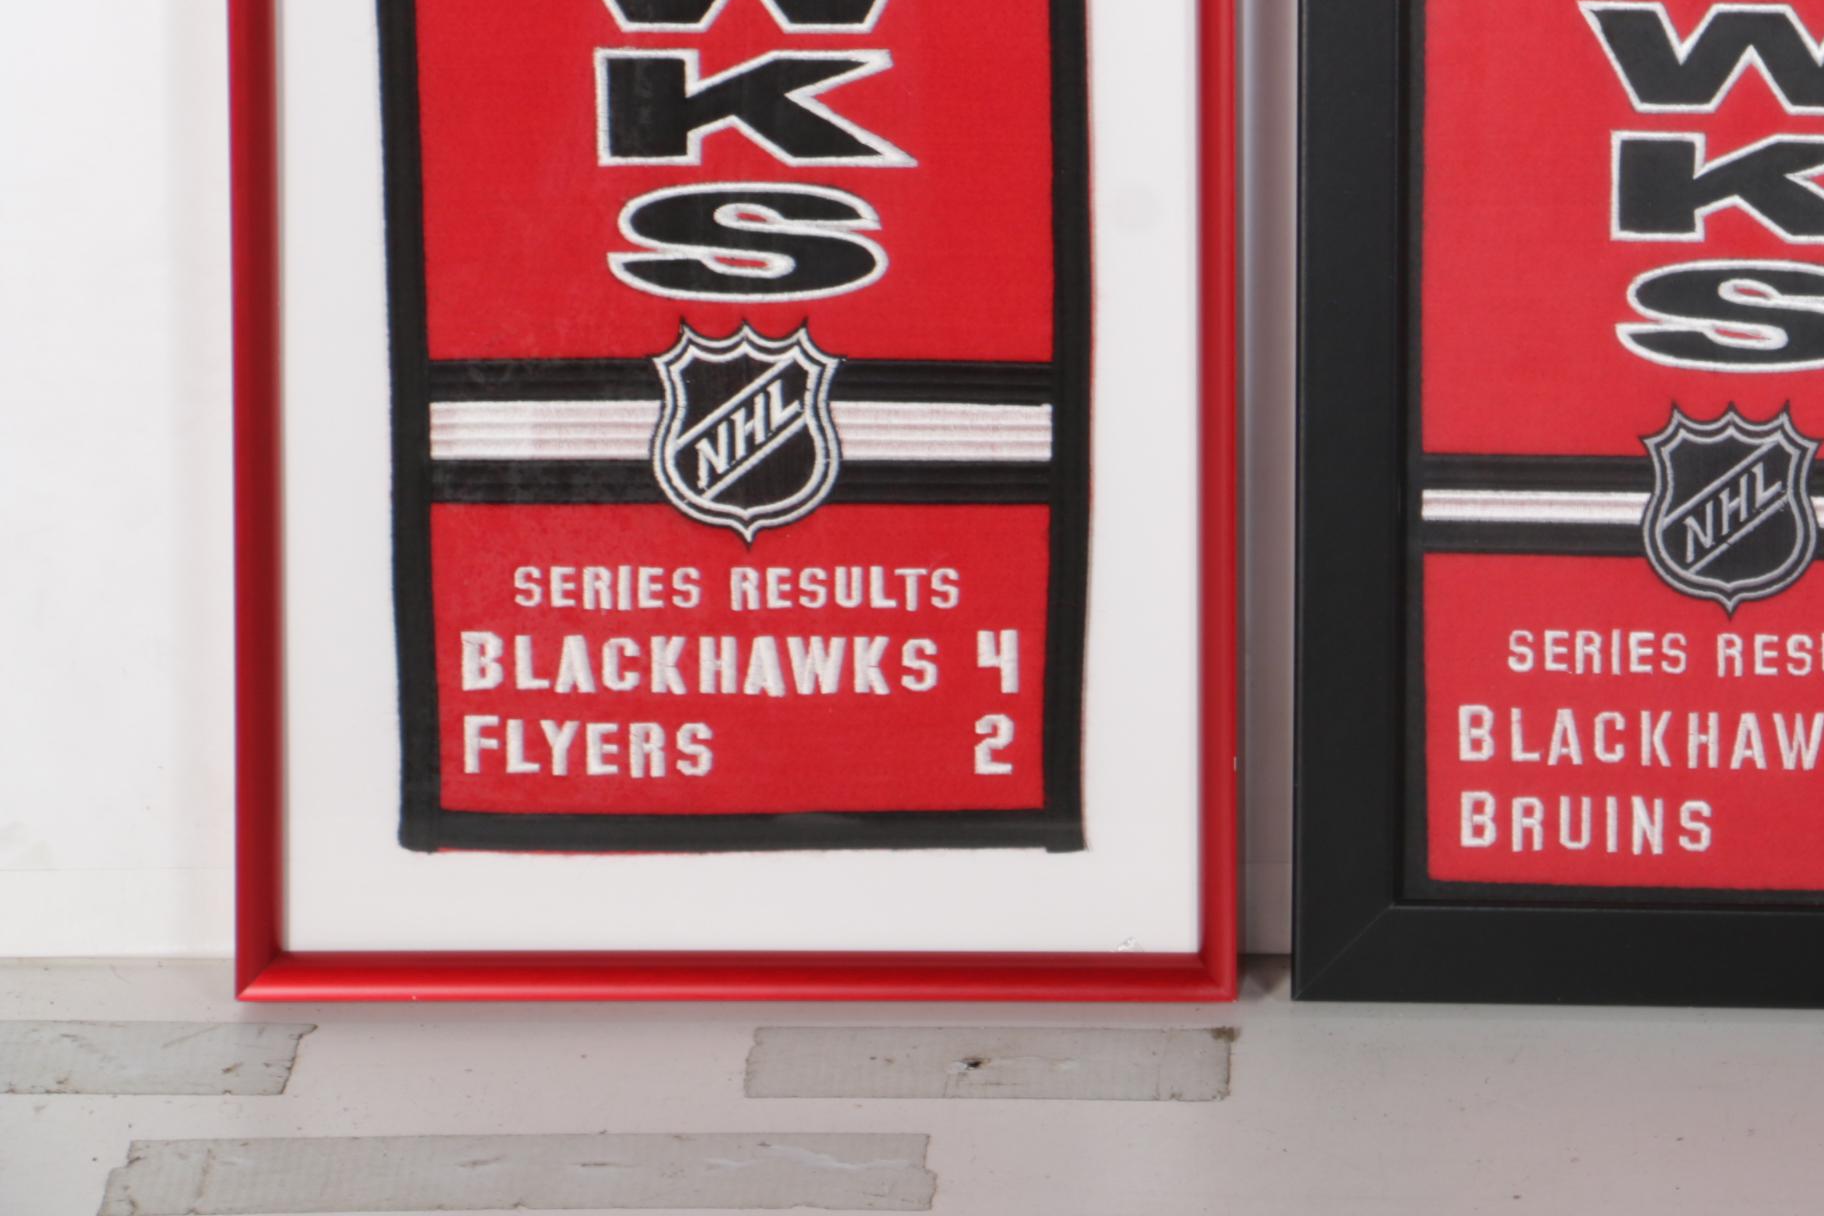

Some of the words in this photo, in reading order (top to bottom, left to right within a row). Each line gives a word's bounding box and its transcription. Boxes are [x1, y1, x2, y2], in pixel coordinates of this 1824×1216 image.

[694, 378, 802, 489] NHL
[1683, 461, 1783, 564] NHL
[515, 566, 699, 610] SERIES
[731, 566, 958, 611] RESULTS
[462, 632, 936, 696] BLACKHAWKS
[978, 630, 1017, 693] 4
[1508, 630, 1686, 674] SERIES
[465, 716, 712, 777] FLYERS
[976, 715, 1013, 774] 2
[1461, 791, 1710, 854] BRUINS
